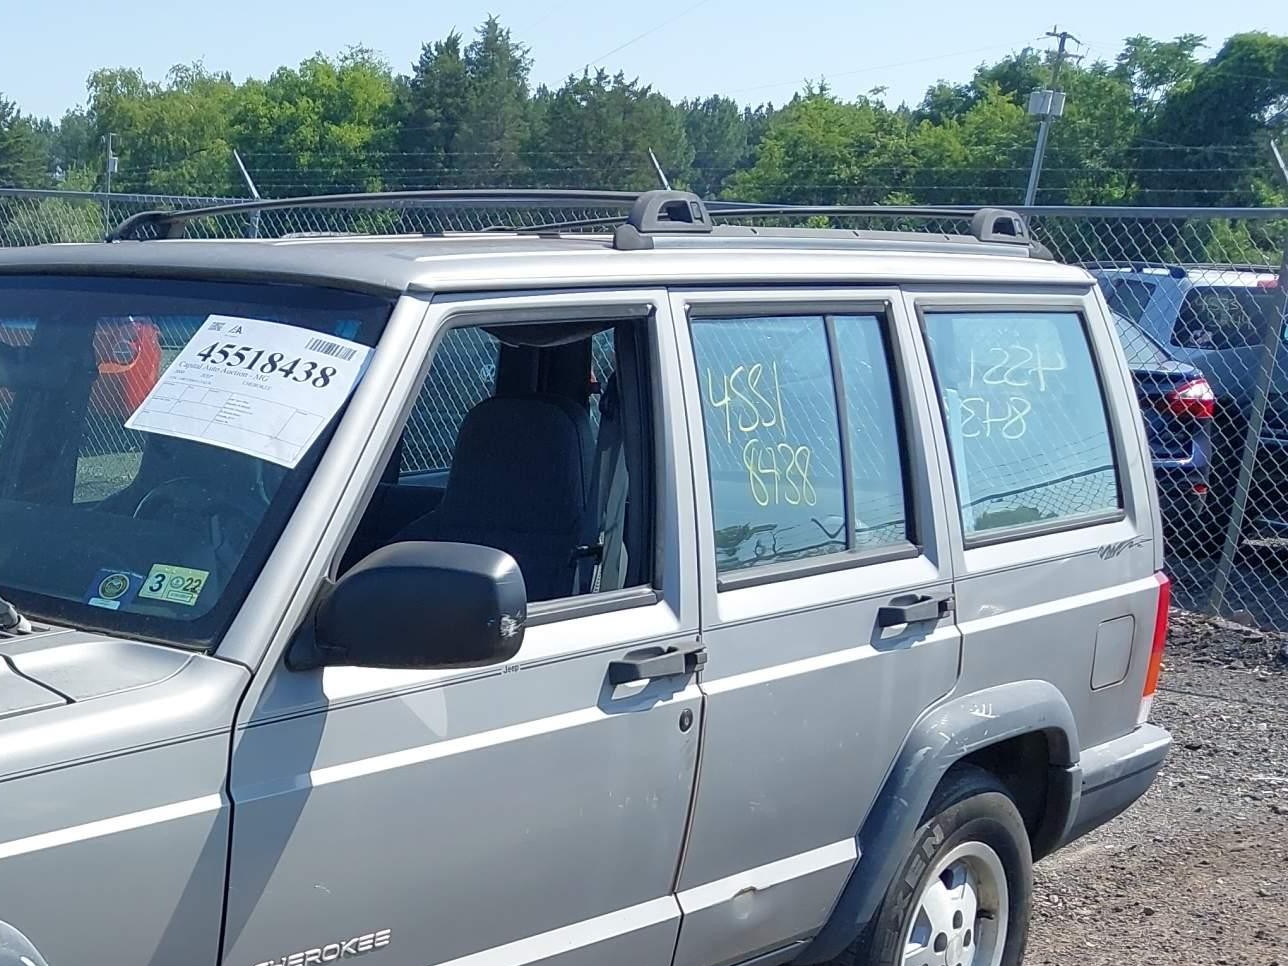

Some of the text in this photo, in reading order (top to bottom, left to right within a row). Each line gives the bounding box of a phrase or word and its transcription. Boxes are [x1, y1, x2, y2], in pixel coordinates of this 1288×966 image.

[196, 341, 337, 388] 45518438
[205, 364, 220, 373] Auto
[220, 367, 248, 378] Auction
[743, 438, 817, 506] 8438
[149, 573, 166, 592] 3
[182, 577, 202, 593] 22
